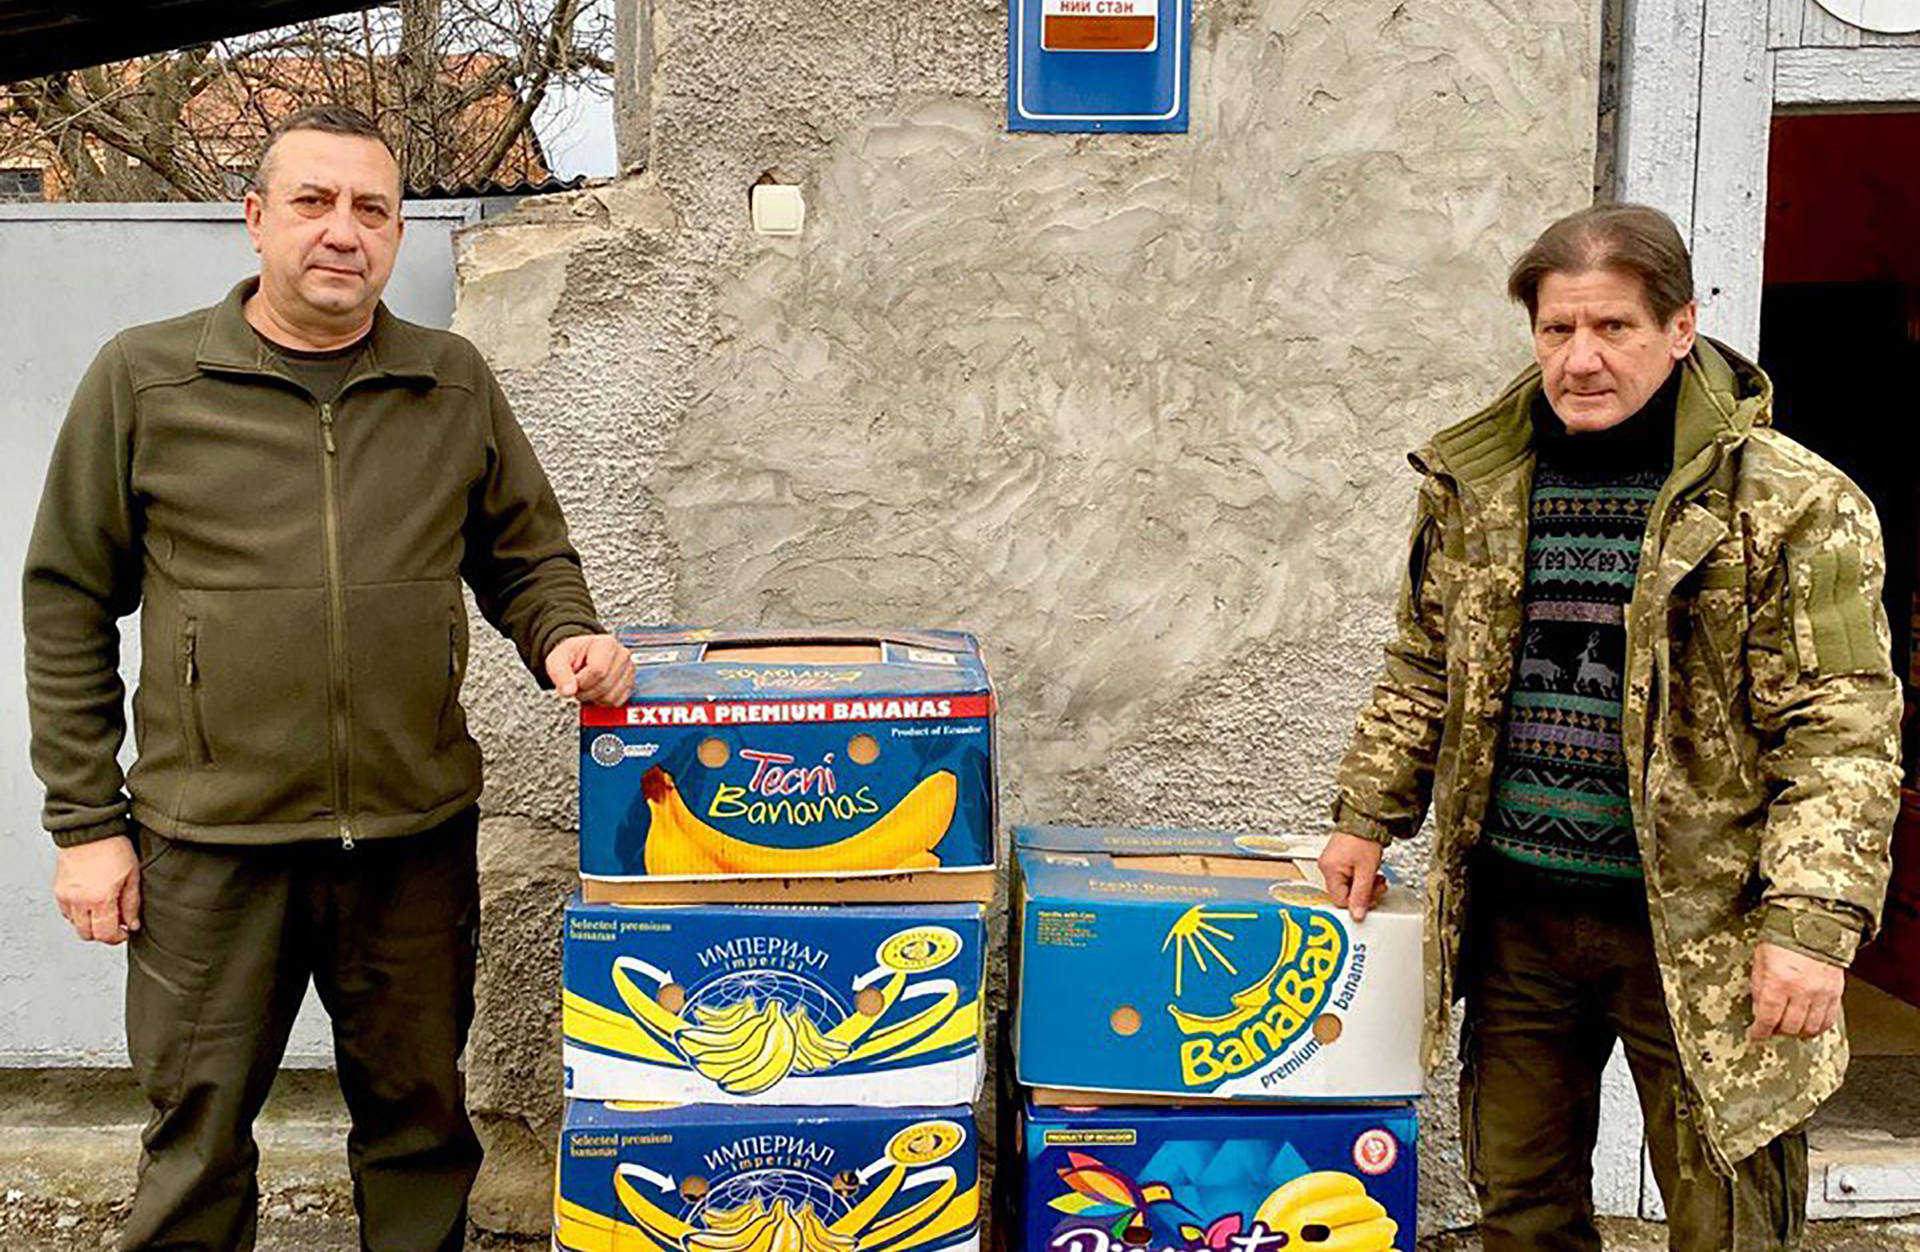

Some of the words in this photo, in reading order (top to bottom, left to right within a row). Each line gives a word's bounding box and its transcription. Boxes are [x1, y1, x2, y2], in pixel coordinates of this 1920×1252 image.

[1096, 1, 1133, 13] стан
[626, 704, 707, 725] EXTRA
[715, 702, 826, 723] PREMIUM
[832, 700, 951, 720] BANANAS
[891, 726, 929, 737] Product
[930, 726, 942, 736] of
[943, 725, 983, 735] Ecuador
[739, 749, 837, 797] Tecni
[708, 782, 879, 826] Bananas
[570, 917, 617, 930] Selected
[620, 920, 672, 934] premium
[569, 929, 616, 941] bananas
[697, 936, 829, 970] ИМПЕРИАЛ
[723, 956, 805, 971] imperial
[1180, 915, 1342, 1087] BanaBay
[1260, 1036, 1324, 1089] premium
[1333, 942, 1367, 1012] bananas
[569, 1132, 618, 1146] Selected
[621, 1132, 673, 1147] premium
[570, 1146, 617, 1158] bananas
[703, 1134, 835, 1170] ИМПЕРИАЛ
[730, 1155, 810, 1172] imperial
